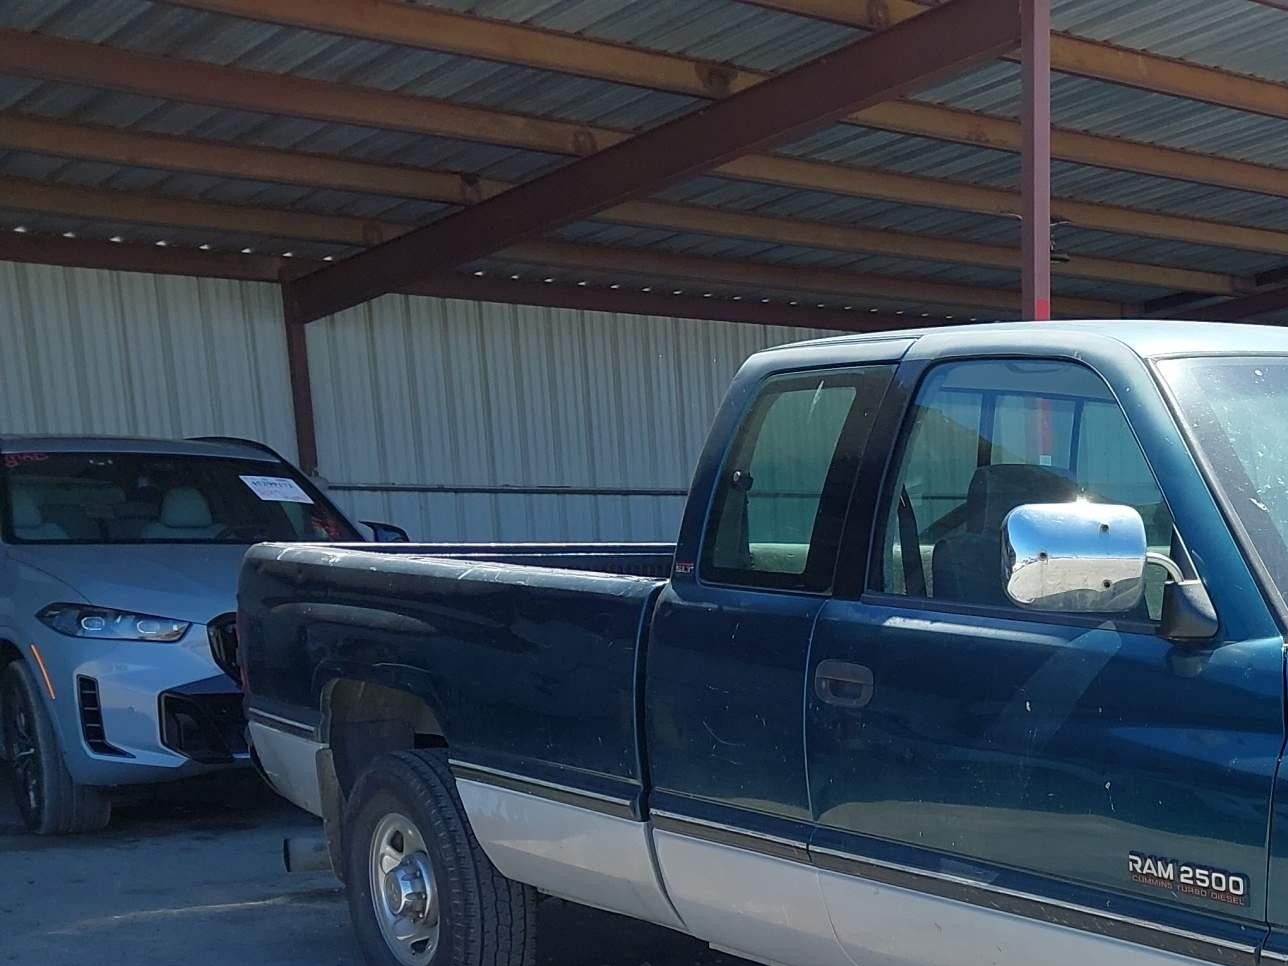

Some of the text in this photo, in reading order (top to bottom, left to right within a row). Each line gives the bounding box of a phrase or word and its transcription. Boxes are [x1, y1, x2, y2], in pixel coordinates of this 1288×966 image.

[1128, 854, 1244, 895] RAM 2500
[1132, 875, 1245, 906] CUMMINS TURBO DIESEL
